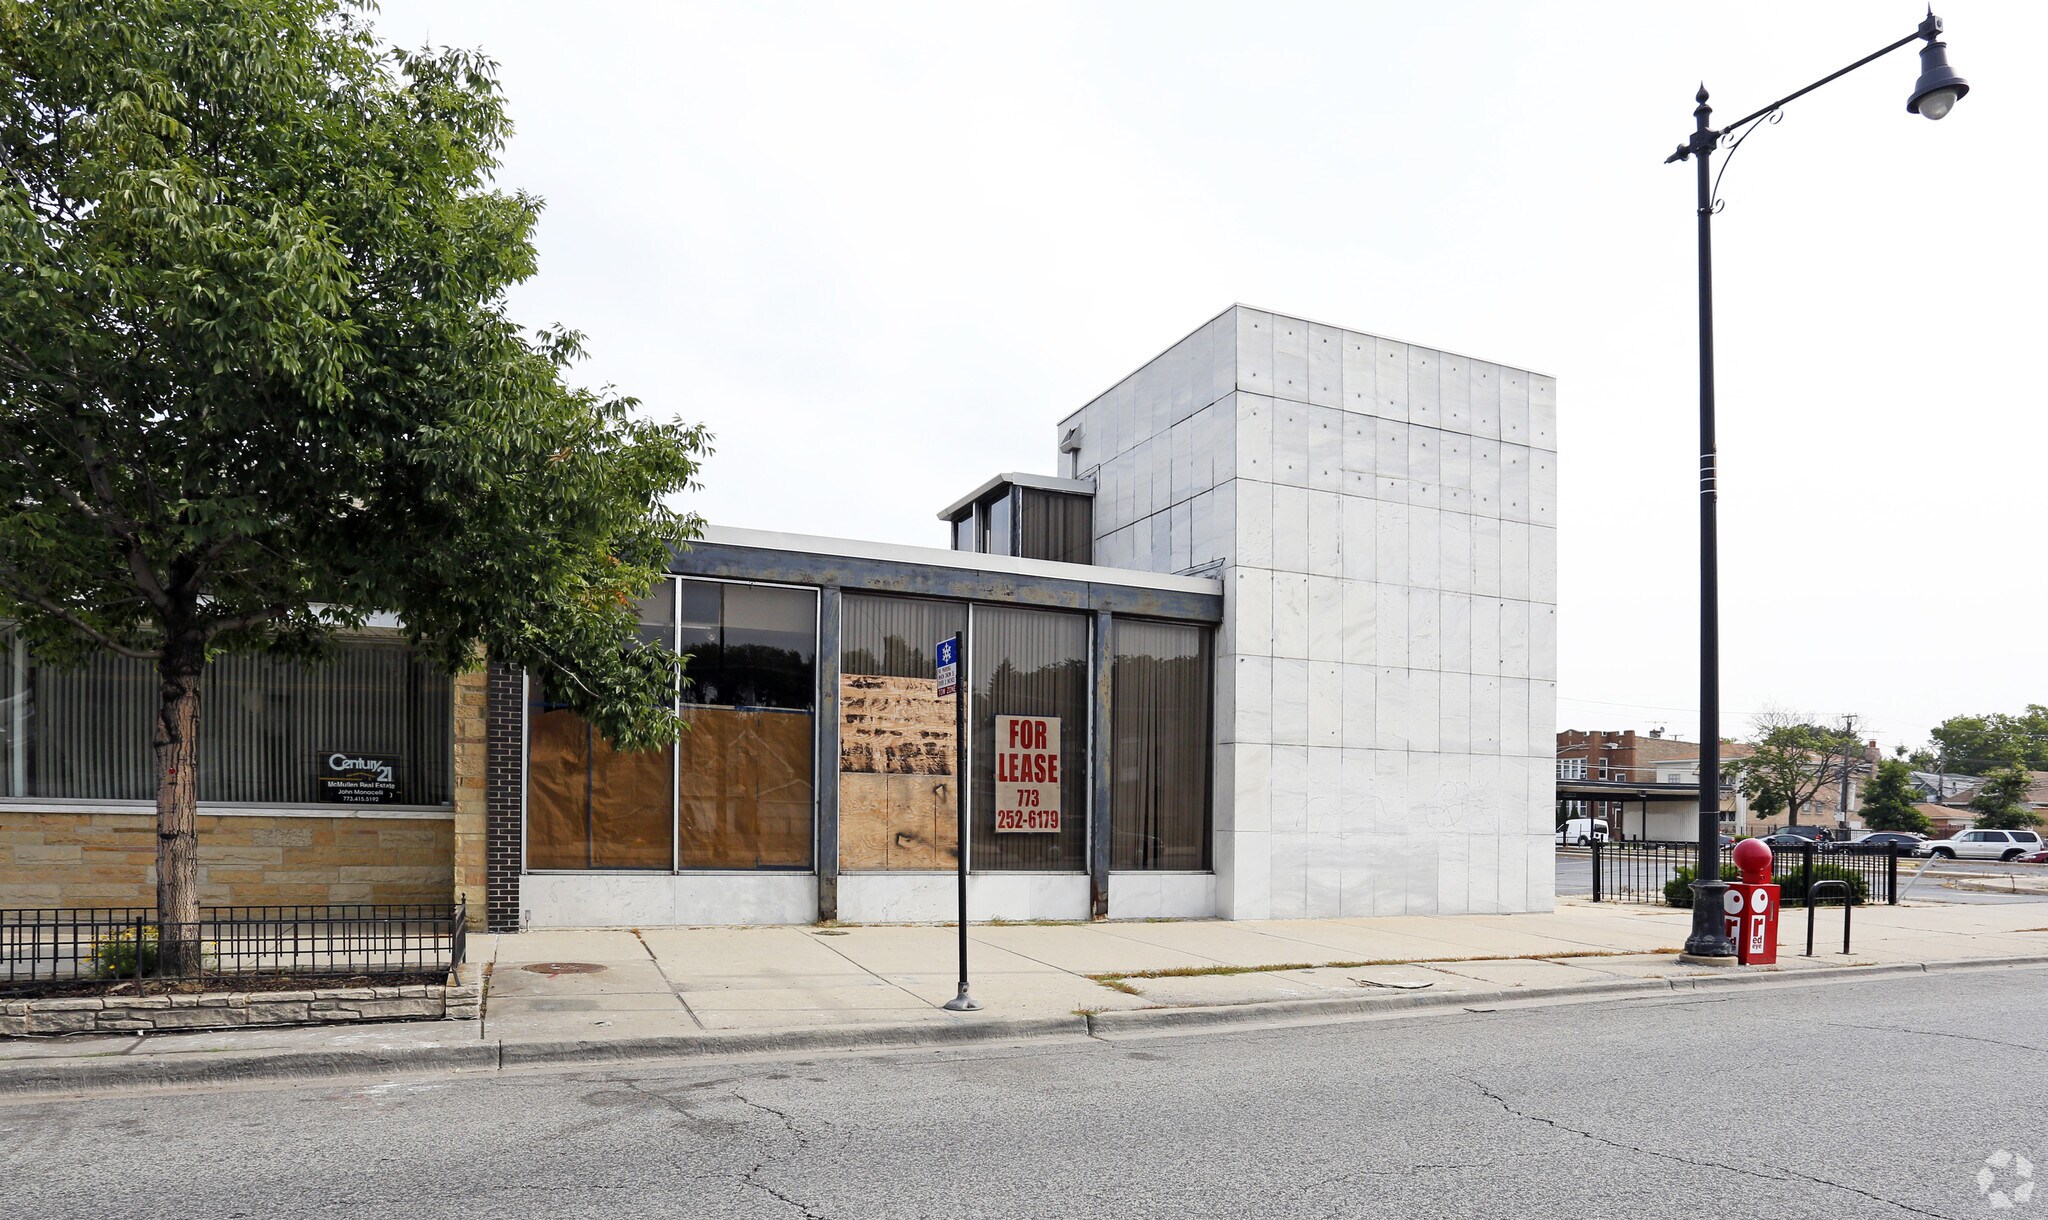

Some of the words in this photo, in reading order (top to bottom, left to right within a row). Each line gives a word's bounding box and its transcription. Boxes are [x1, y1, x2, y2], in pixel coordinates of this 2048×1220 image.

[1009, 719, 1047, 750] FOR
[329, 753, 383, 772] Century
[376, 766, 392, 782] 21
[998, 752, 1058, 784] LEASE
[1017, 789, 1040, 808] 773
[997, 809, 1059, 829] 252-6179
